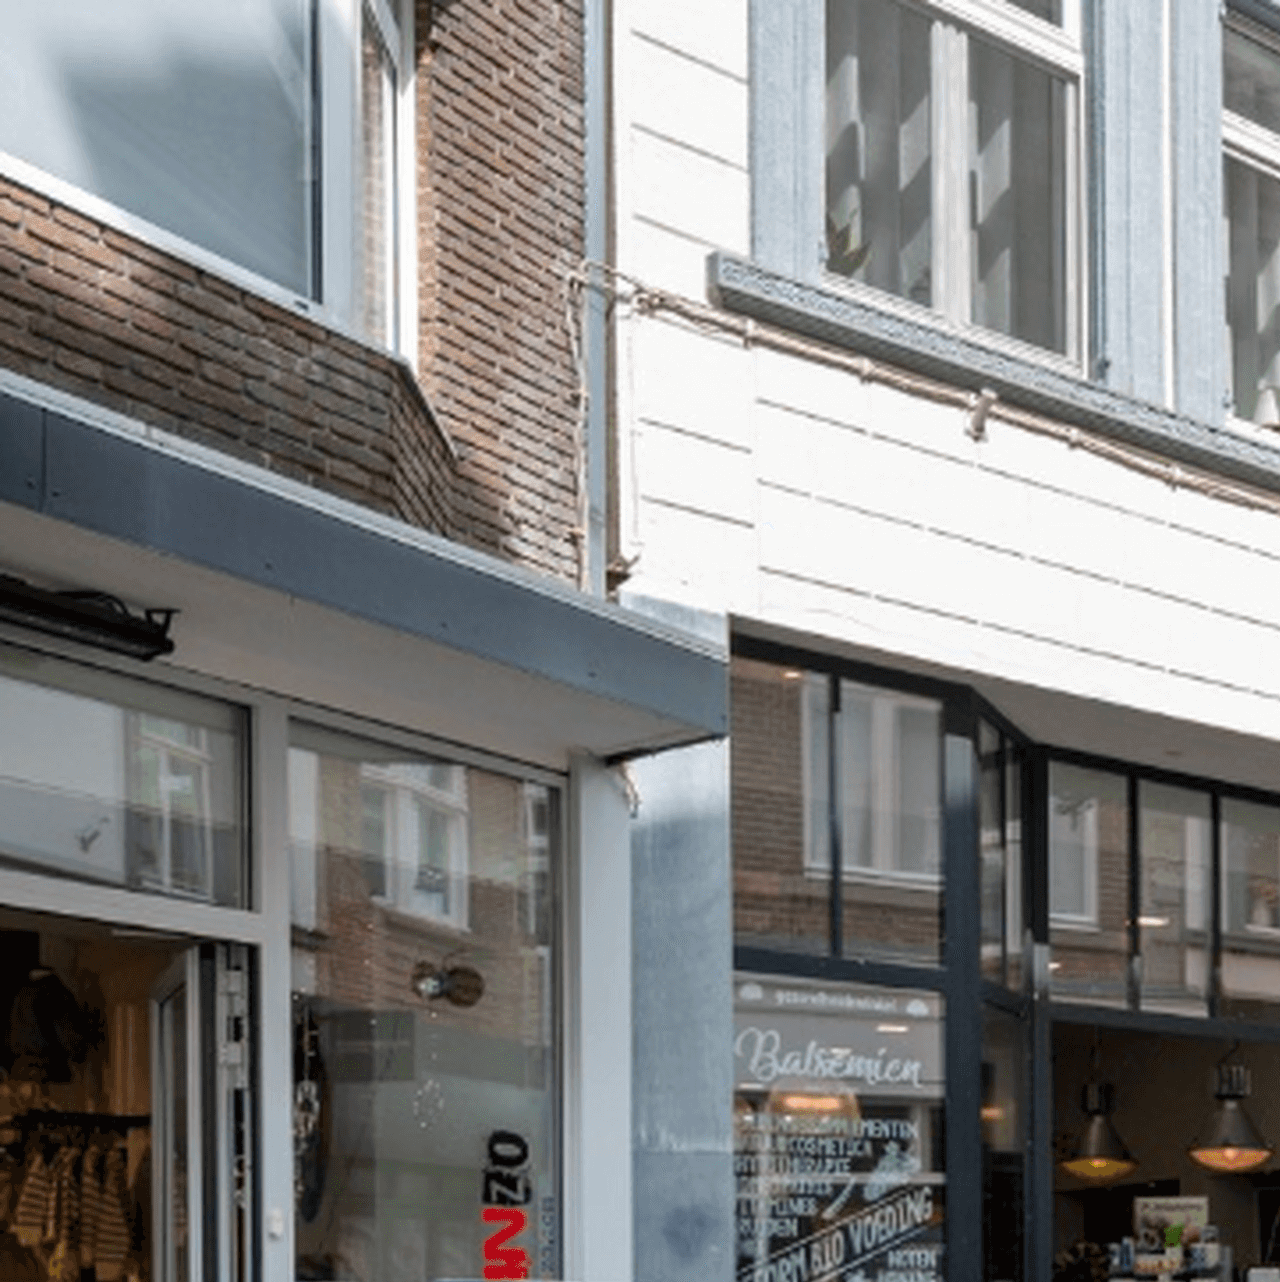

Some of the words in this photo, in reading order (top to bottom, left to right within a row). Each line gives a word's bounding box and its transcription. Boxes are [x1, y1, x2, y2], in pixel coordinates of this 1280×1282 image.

[736, 1026, 922, 1087] Balsemien
[810, 1230, 845, 1276] BIO
[849, 1186, 933, 1254] VOEDING
